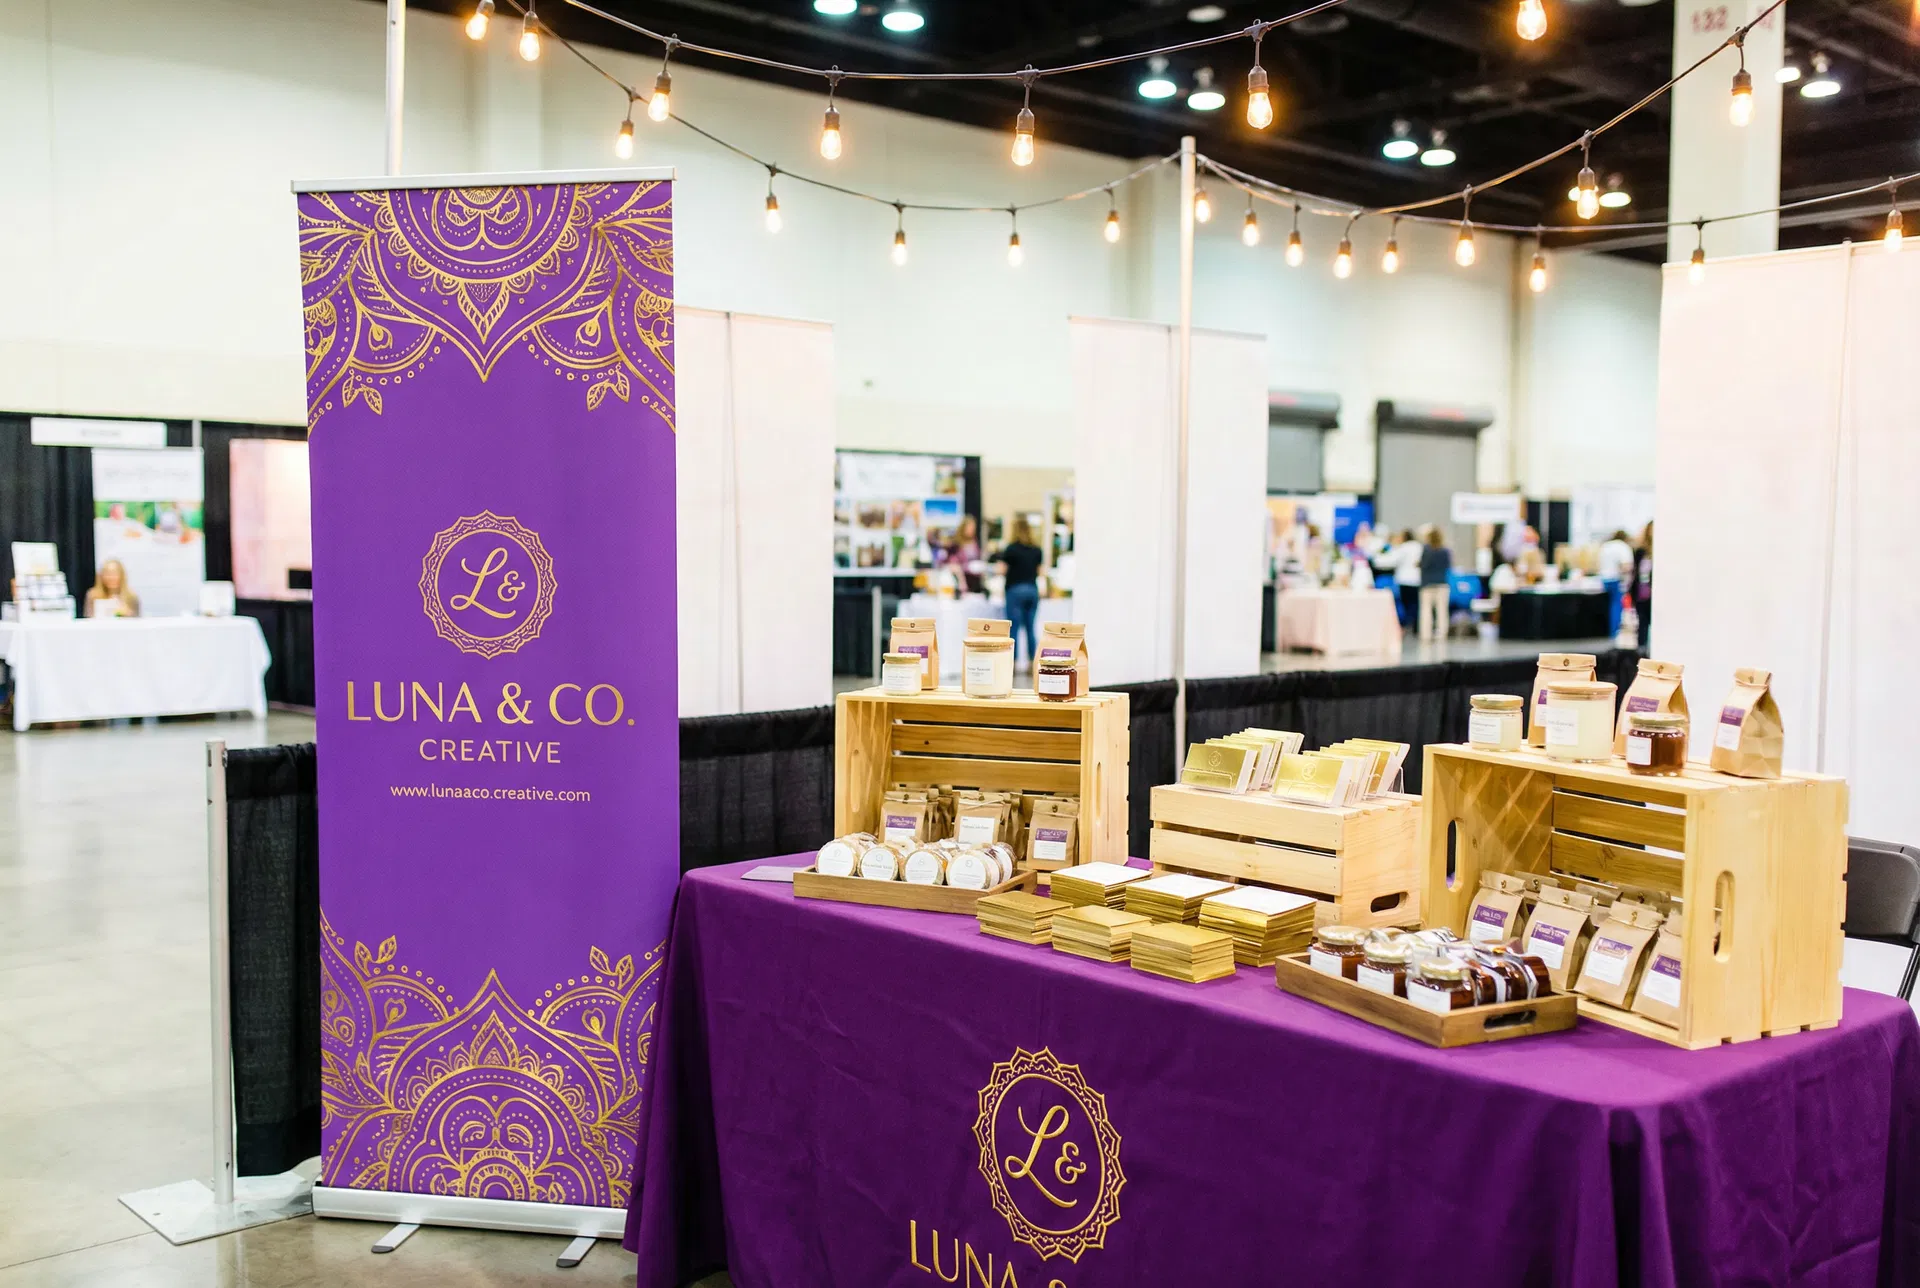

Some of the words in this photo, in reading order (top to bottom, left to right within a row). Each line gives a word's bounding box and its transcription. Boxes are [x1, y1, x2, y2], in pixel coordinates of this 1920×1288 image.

[346, 680, 482, 723] LUNA
[496, 682, 534, 725] &
[548, 683, 635, 726] CO.
[419, 738, 561, 764] CREATIVE
[390, 783, 591, 802] www.lunaaco.creative.com
